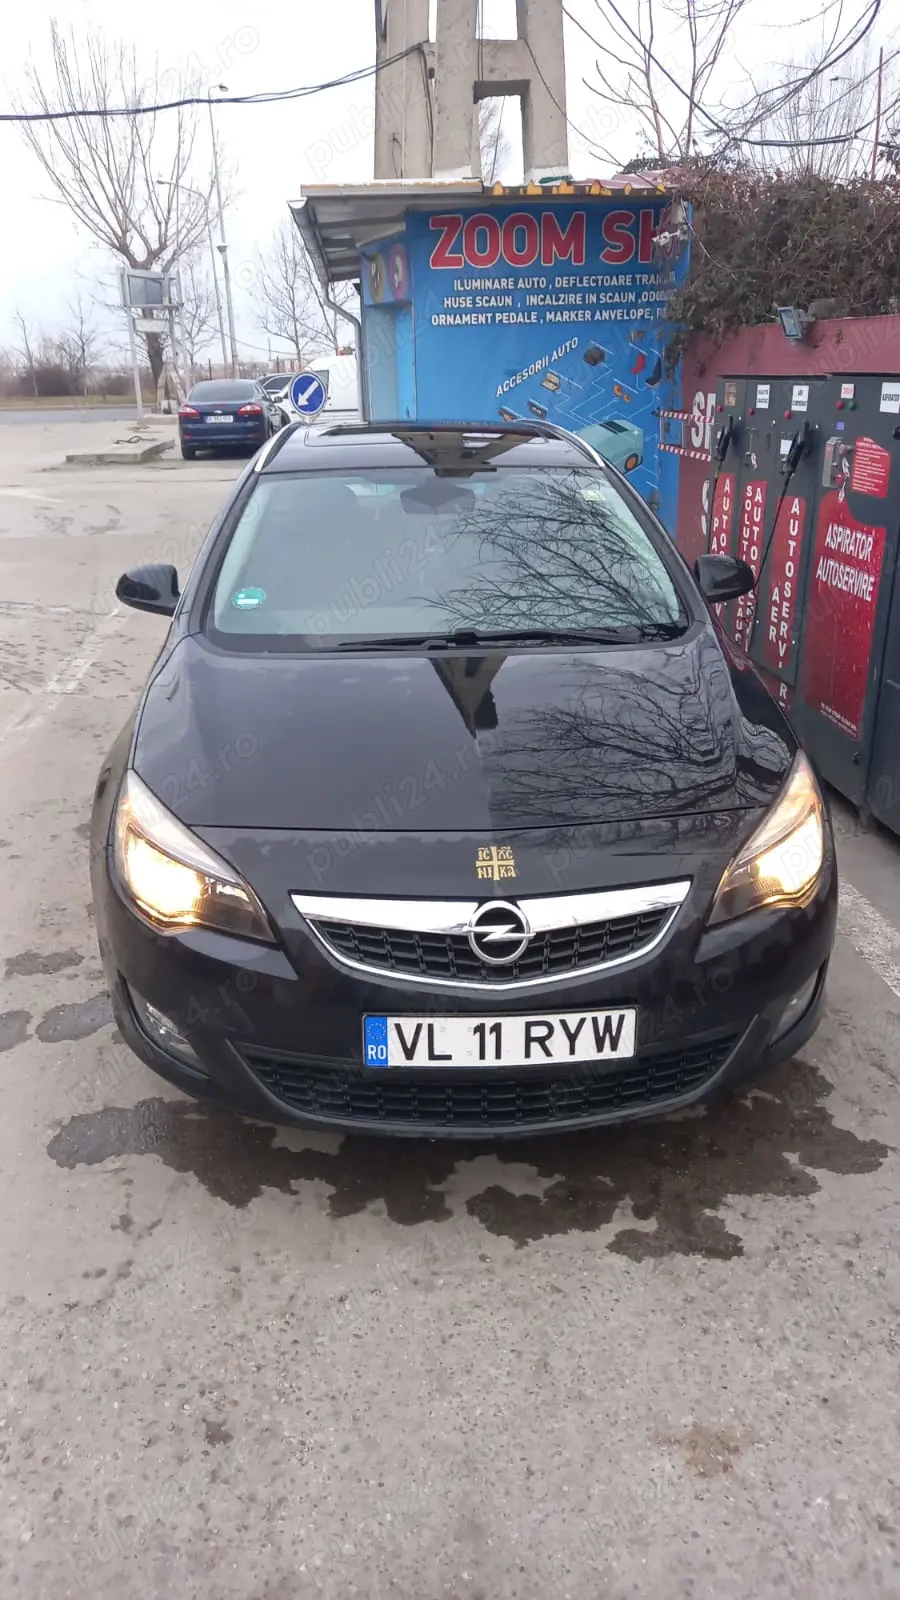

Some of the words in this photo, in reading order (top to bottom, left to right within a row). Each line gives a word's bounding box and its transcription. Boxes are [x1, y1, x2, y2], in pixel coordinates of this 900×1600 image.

[429, 211, 586, 269] ZOOM
[600, 209, 681, 265] SH
[444, 297, 472, 307] HUSE
[526, 293, 583, 306] INCALZIRE
[585, 293, 597, 305] IN
[454, 279, 515, 291] ILUMINARE
[555, 275, 633, 289] DEFLECTOARE
[431, 314, 493, 326] ORNAMENT
[546, 310, 592, 323] MARKER
[594, 308, 654, 321] ANVELOPE,
[496, 353, 549, 398] ACCESORII
[550, 336, 579, 364] AUTO
[825, 522, 873, 563] ASPIRATOR
[816, 556, 875, 602] AUTOSERVIRE
[769, 587, 781, 642] AER
[368, 1044, 386, 1060] RO
[394, 1022, 452, 1061] VL
[473, 1022, 502, 1060] 11
[524, 1013, 625, 1060] RYW
